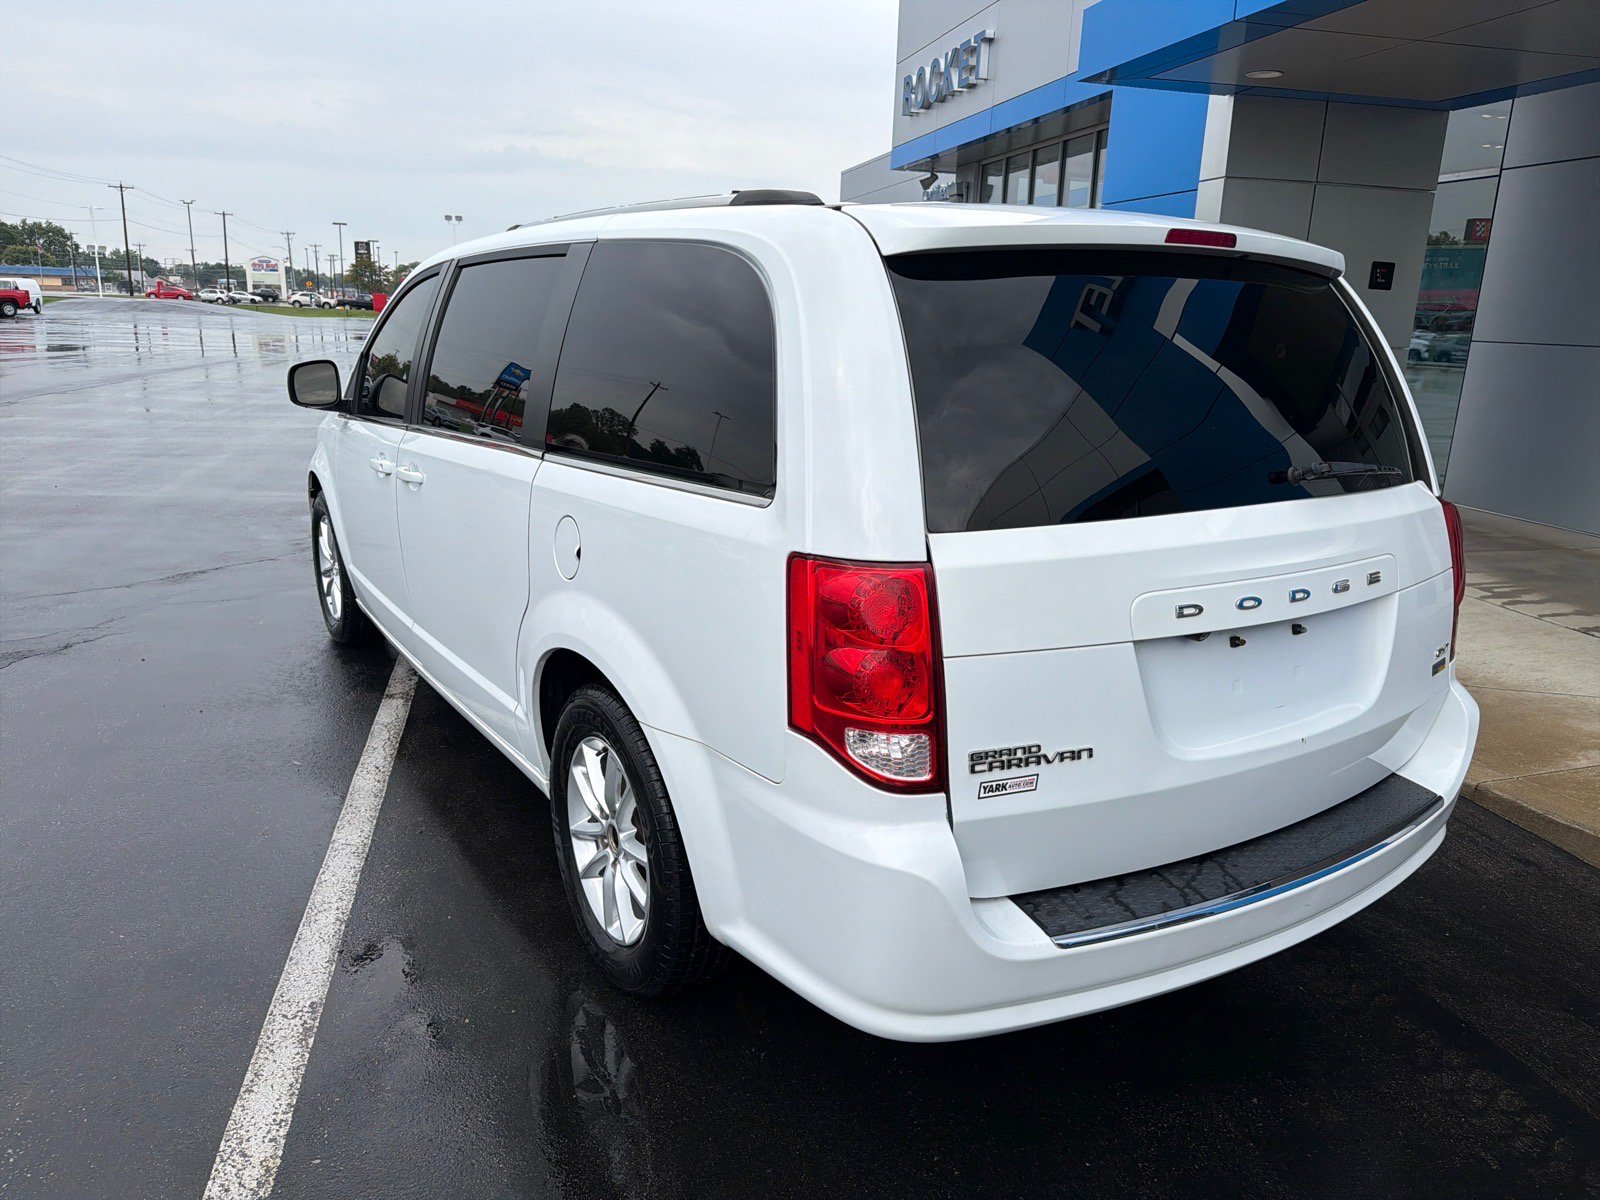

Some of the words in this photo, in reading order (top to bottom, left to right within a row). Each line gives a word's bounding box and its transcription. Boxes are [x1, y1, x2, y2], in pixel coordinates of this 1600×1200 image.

[902, 30, 994, 116] ROCKET
[1175, 570, 1381, 618] DODGE
[969, 744, 1041, 761] GRAND
[969, 747, 1093, 774] CARAVAN
[981, 782, 1009, 795] YARK
